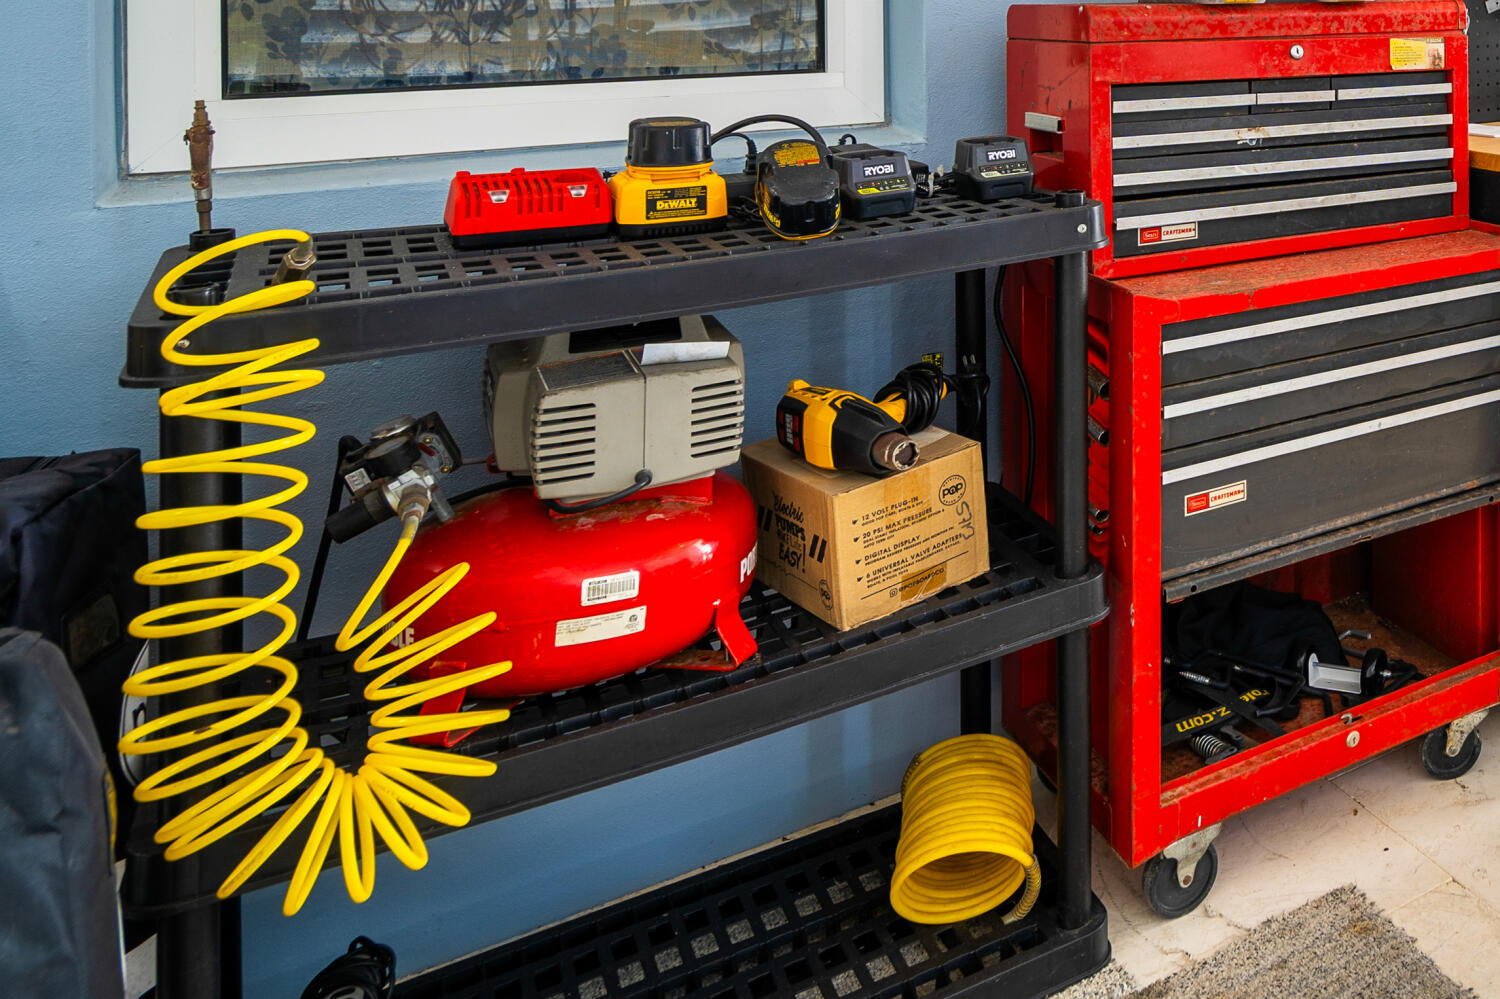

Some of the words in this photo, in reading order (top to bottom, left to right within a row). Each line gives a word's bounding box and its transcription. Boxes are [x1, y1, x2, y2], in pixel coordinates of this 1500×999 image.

[987, 149, 1016, 161] RYOBI
[863, 164, 895, 177] RYOBI
[1210, 489, 1241, 502] CRAFTSMAN
[862, 513, 869, 521] 12
[871, 506, 888, 517] VOLT
[890, 496, 919, 510] PLUG-IN
[863, 531, 871, 539] 20
[873, 526, 883, 535] PSI
[885, 520, 901, 530] MAX
[903, 507, 932, 524] PRESSURE
[864, 547, 891, 561] DIGITAL
[893, 535, 920, 549] DISPLAY
[872, 557, 909, 576] UNIVERSAL
[910, 548, 930, 560] VALVE
[932, 532, 962, 550] ADAPTERS
